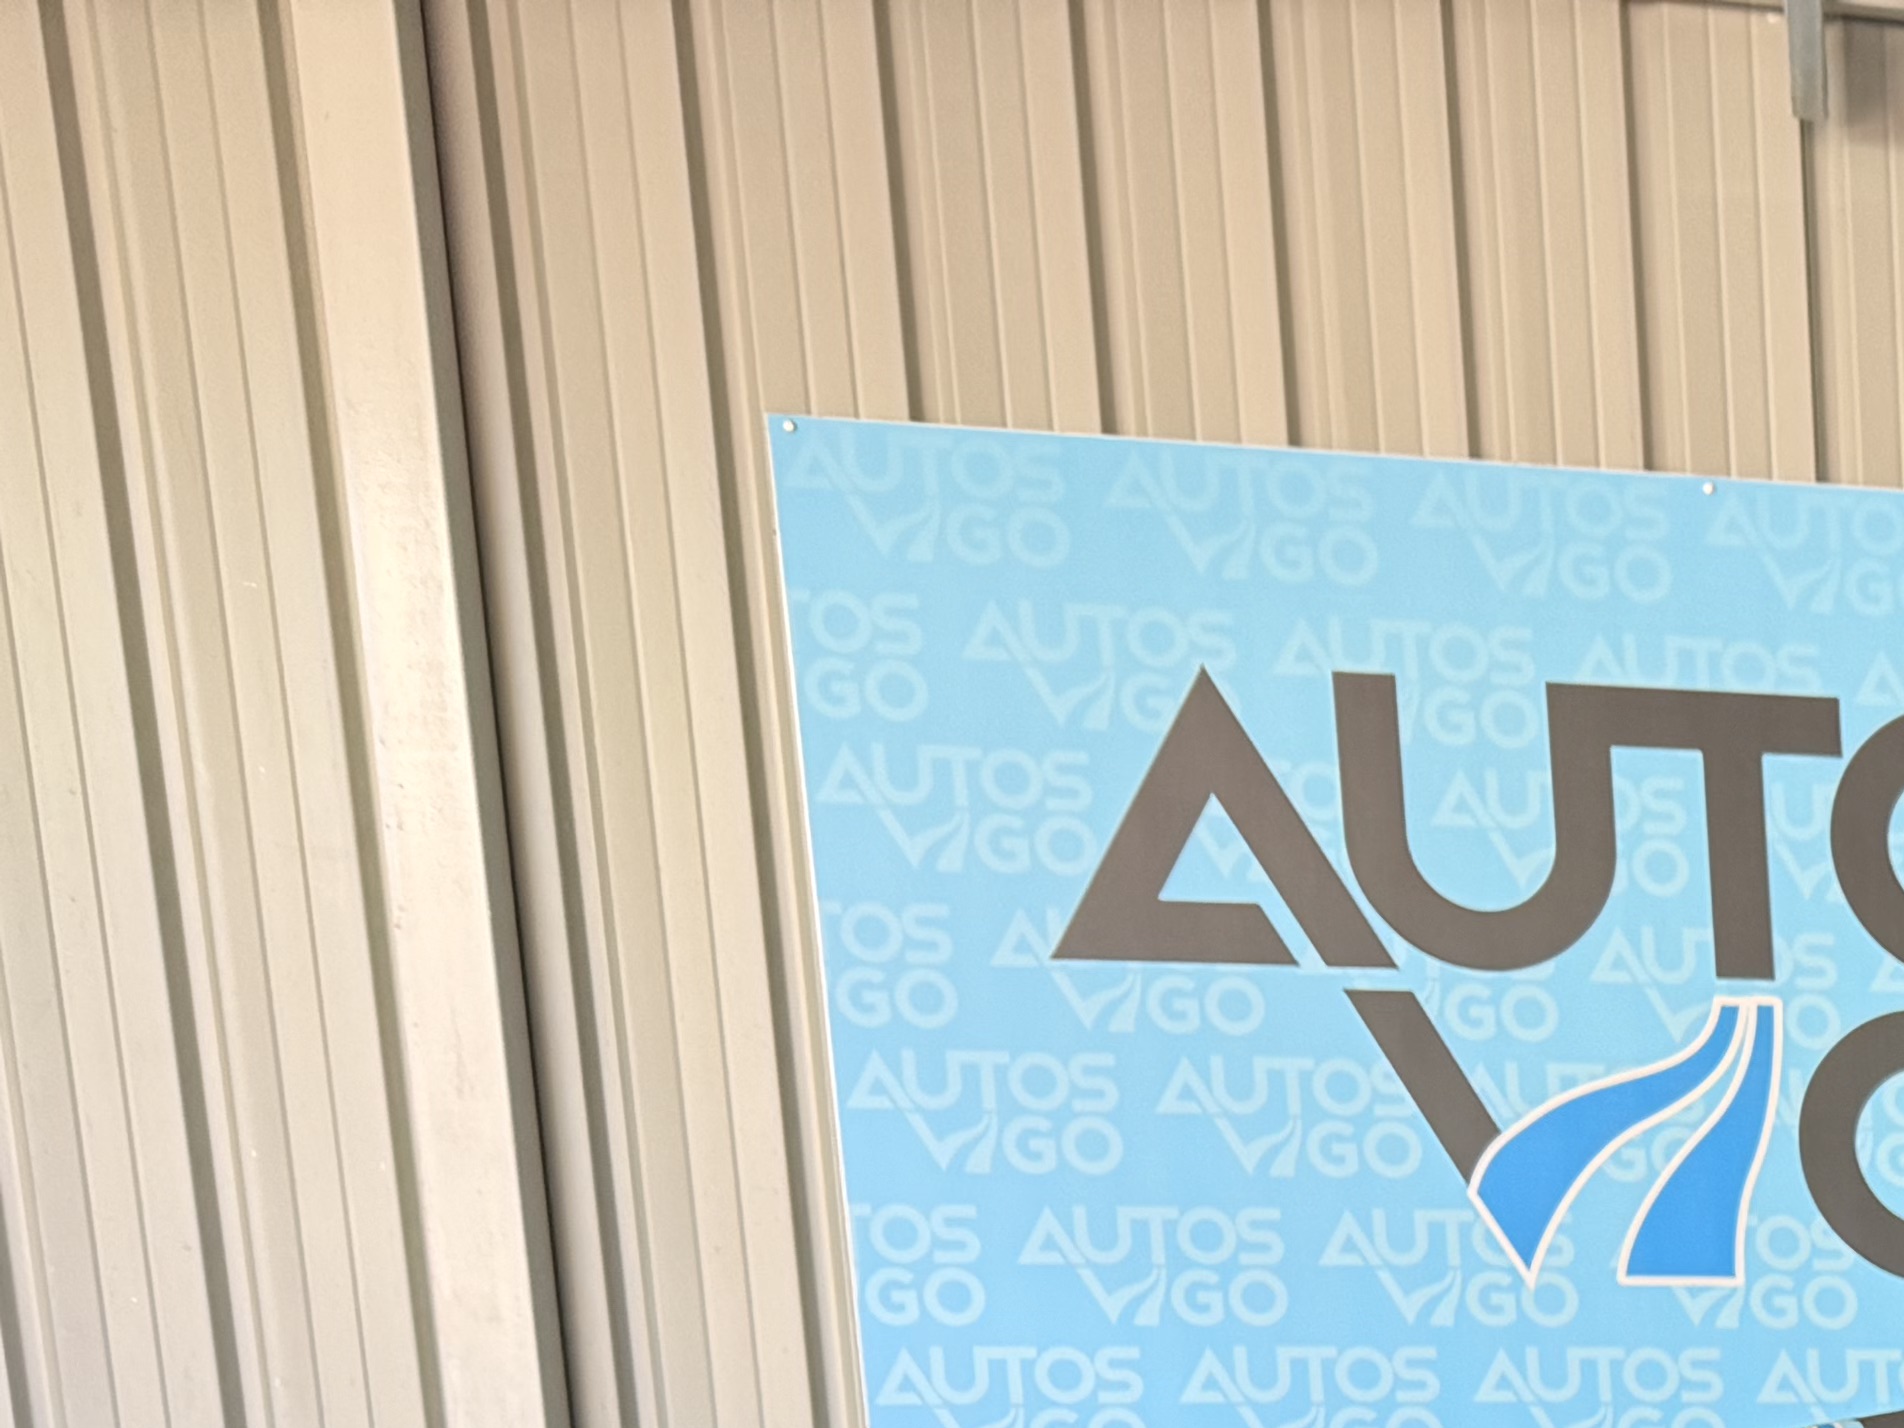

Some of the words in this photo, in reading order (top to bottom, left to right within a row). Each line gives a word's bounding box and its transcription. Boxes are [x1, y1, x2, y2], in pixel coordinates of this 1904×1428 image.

[787, 430, 1061, 502] AUTOS
[1109, 450, 1371, 520] AUTOS
[1415, 471, 1666, 539] AUTOS
[966, 600, 1232, 668] AUTOS
[819, 744, 1089, 810] AUTOS
[850, 1050, 1116, 1111] AUTOS
[1023, 1206, 1281, 1264] AUTOS
[878, 1346, 1141, 1405] AUTOS
[1185, 1346, 1436, 1403] AUTOS
[1479, 1346, 1720, 1402] AUTOS
